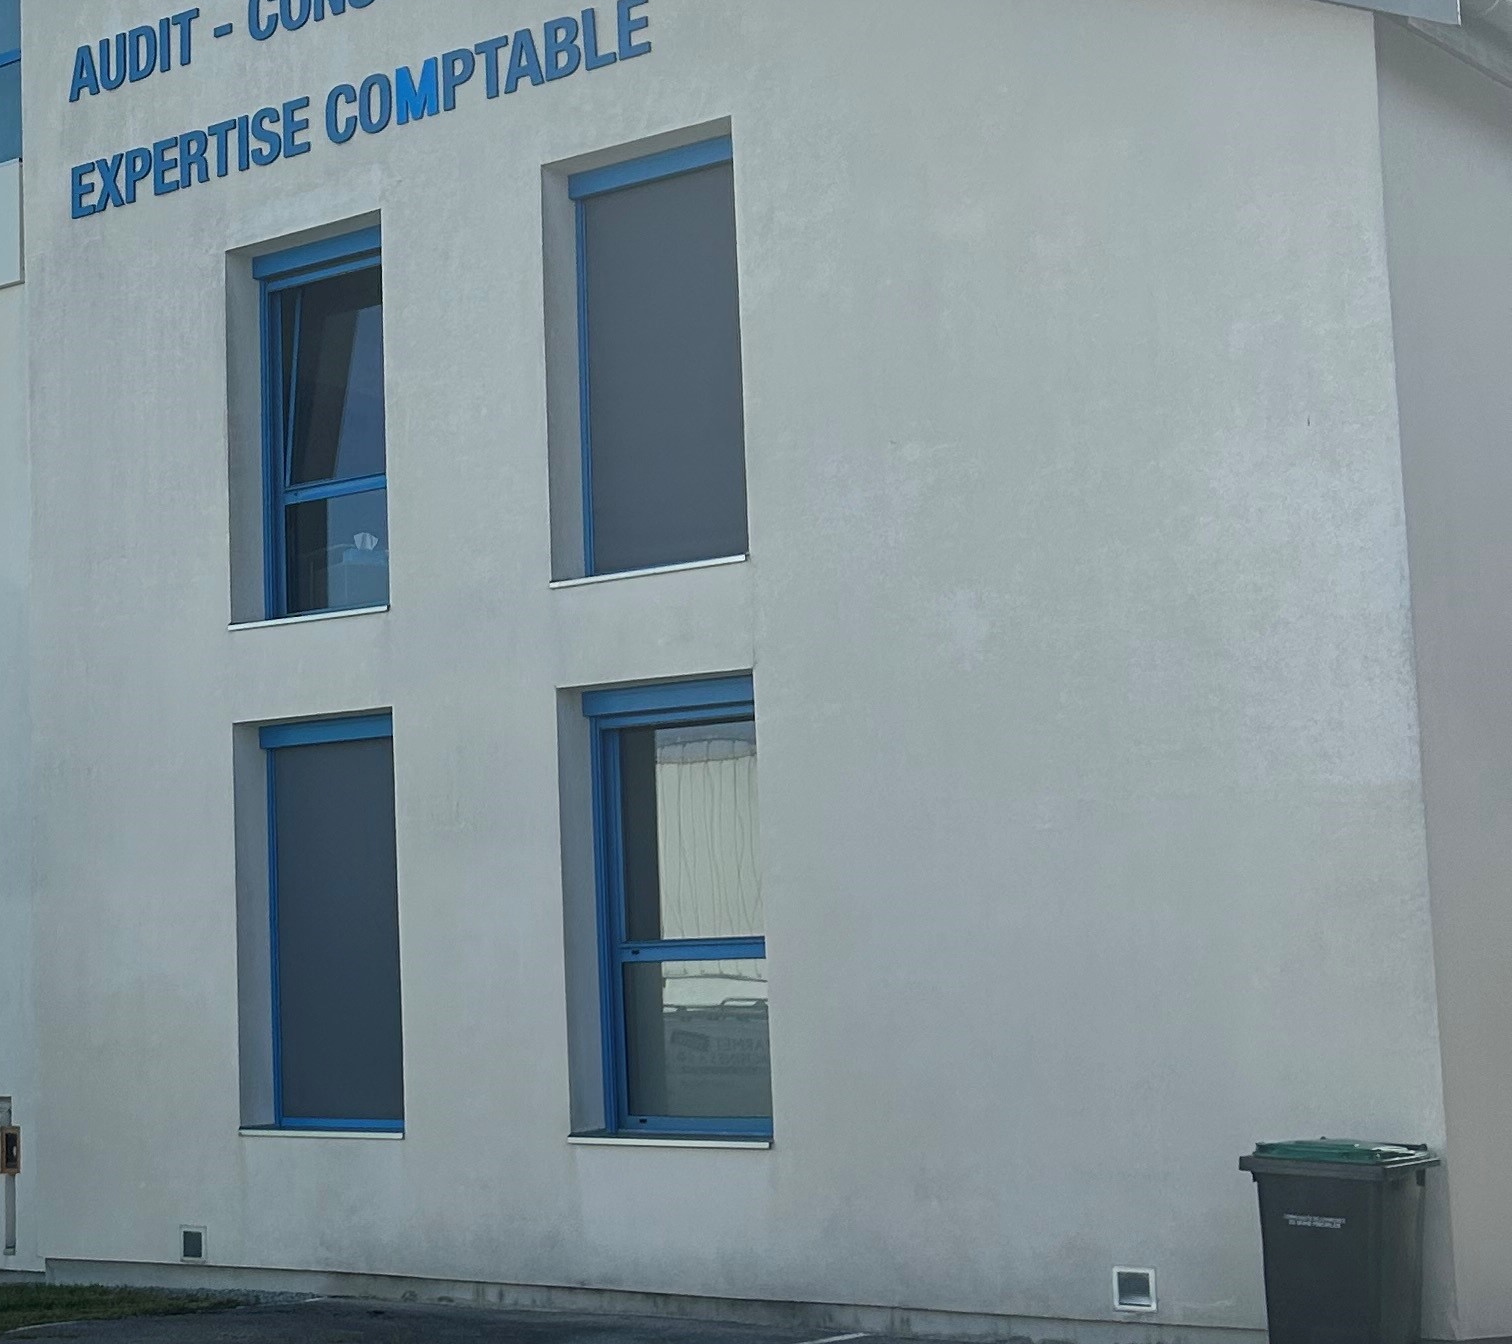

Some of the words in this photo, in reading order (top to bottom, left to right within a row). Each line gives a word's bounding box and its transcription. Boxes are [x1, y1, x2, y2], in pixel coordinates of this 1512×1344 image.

[68, 7, 201, 104] AUDIT
[213, 22, 234, 39] -
[70, 95, 312, 220] EXPERTISE
